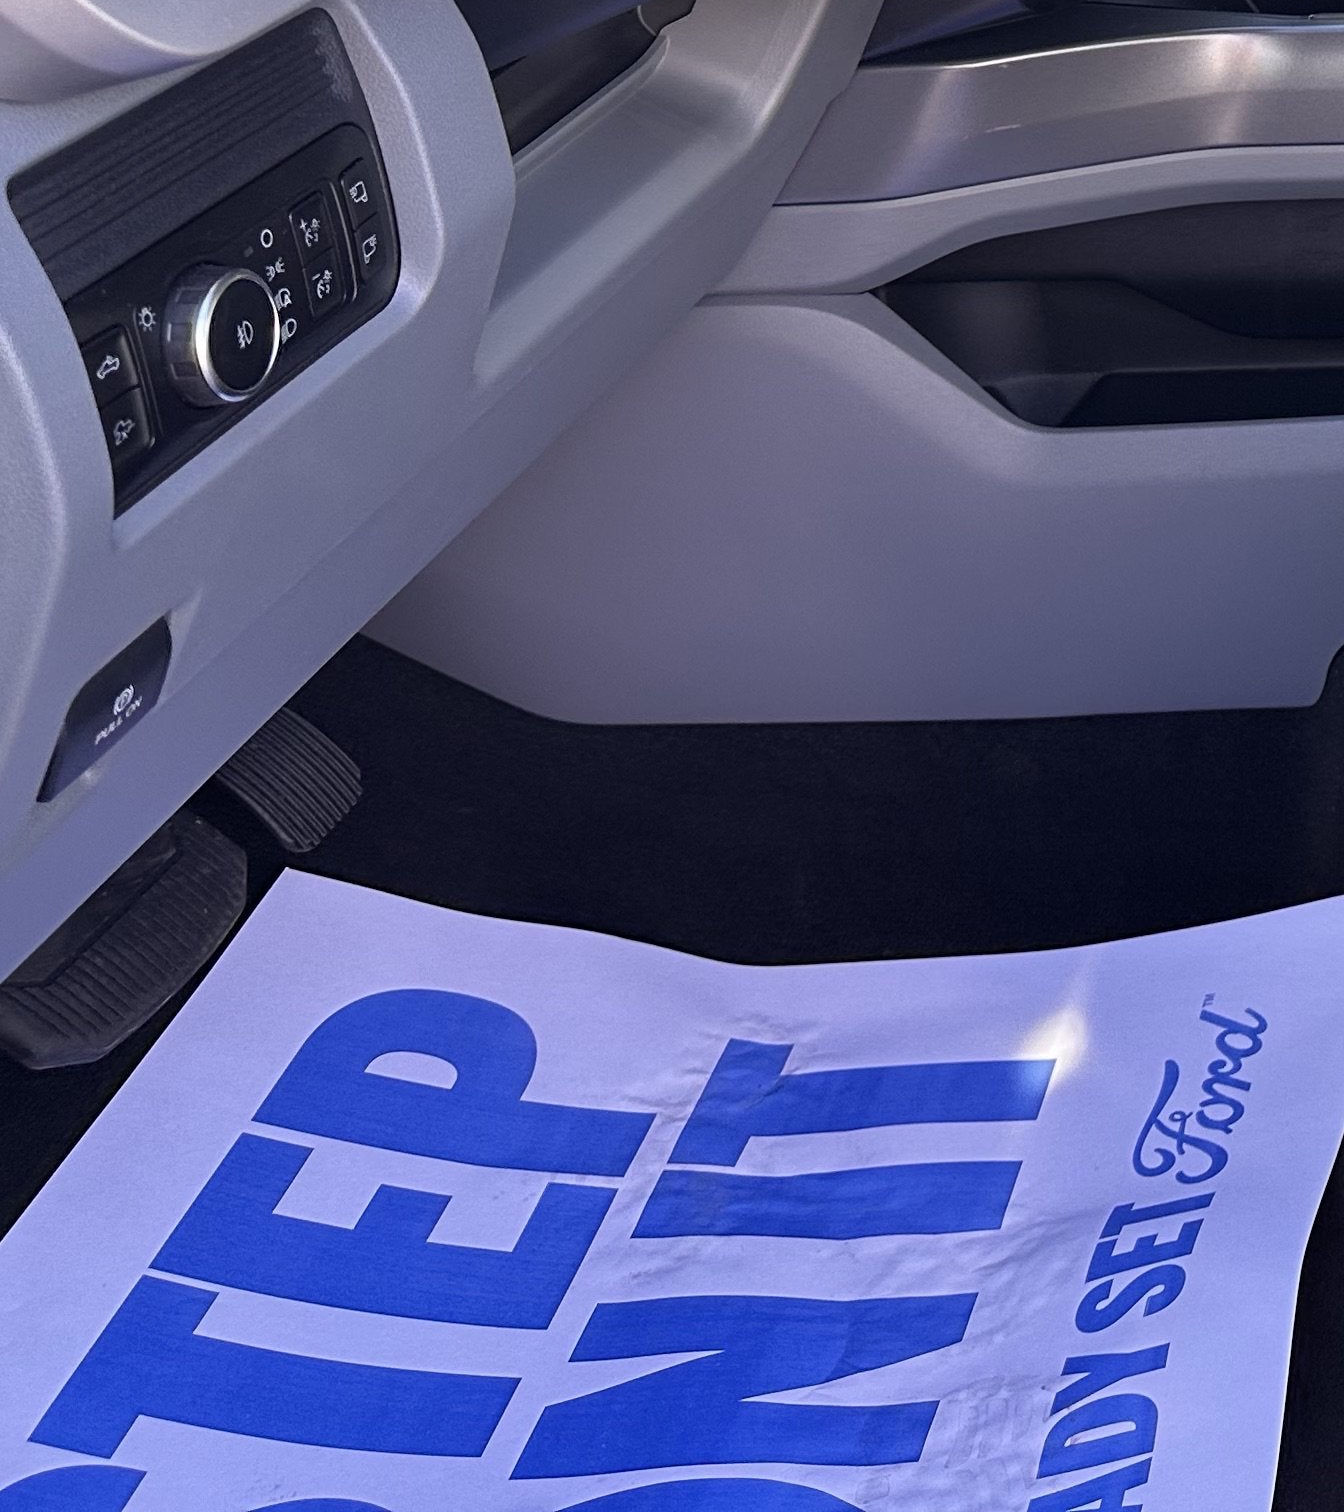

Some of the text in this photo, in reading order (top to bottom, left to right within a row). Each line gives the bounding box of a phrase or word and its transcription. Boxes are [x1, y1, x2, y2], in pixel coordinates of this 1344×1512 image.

[1132, 1006, 1268, 1185] Ford
[1075, 1191, 1217, 1334] SET
[508, 1291, 980, 1512] N
